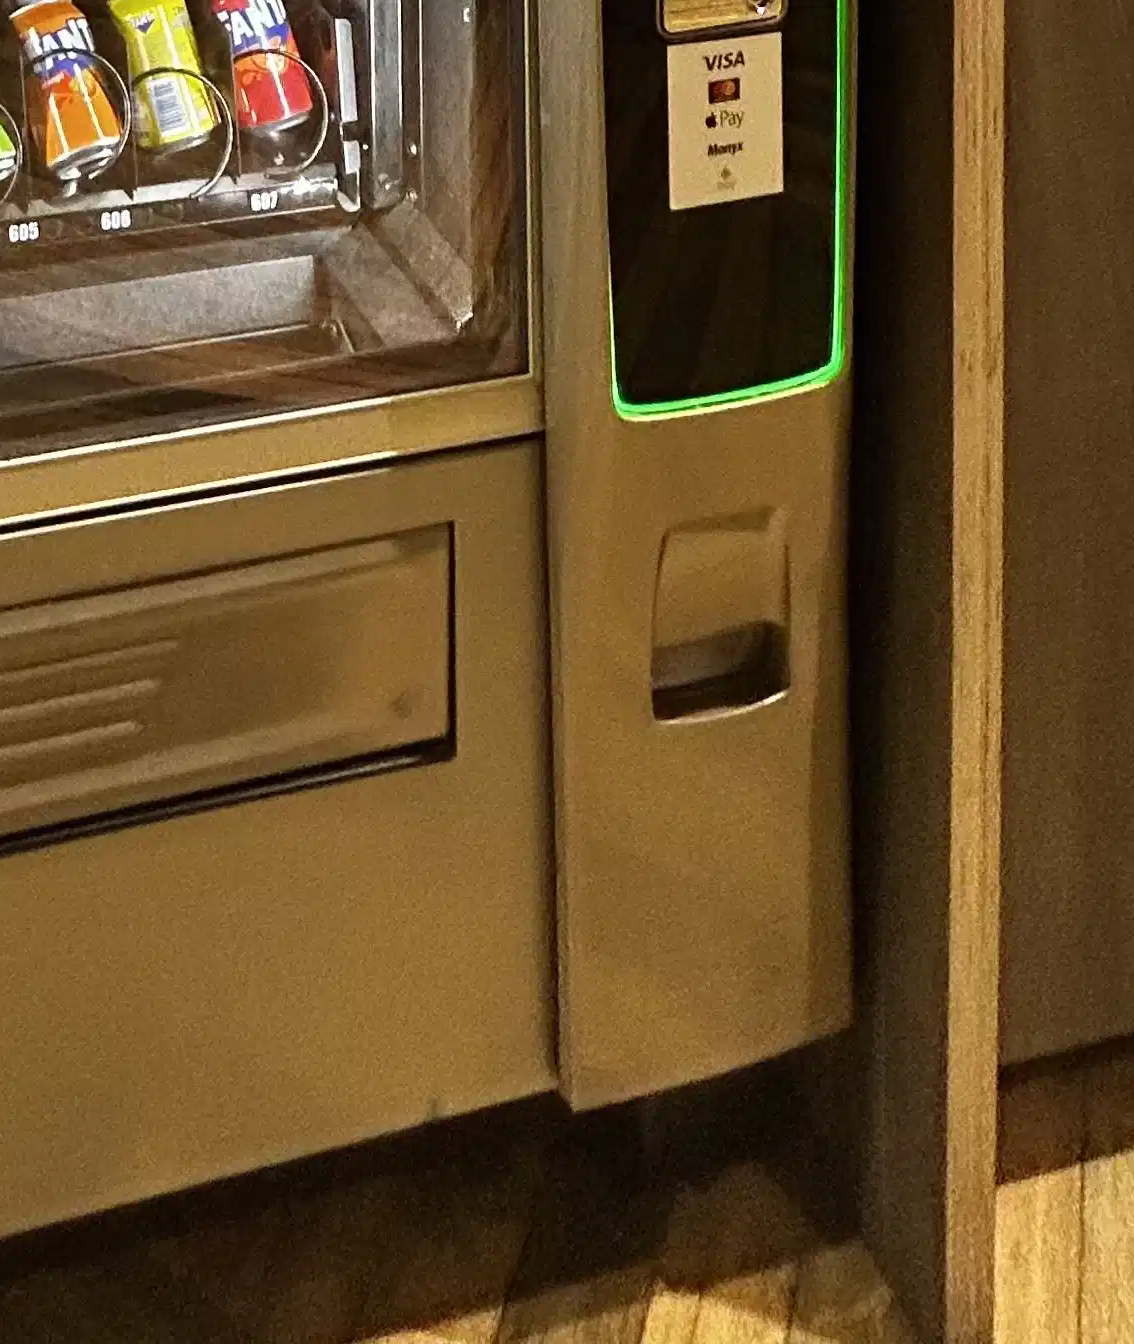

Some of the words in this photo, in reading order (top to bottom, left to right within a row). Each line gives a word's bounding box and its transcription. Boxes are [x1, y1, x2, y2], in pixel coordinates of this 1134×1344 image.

[703, 50, 746, 72] VISA
[719, 110, 744, 129] Pay
[250, 191, 280, 212] 607
[8, 222, 40, 243] 605
